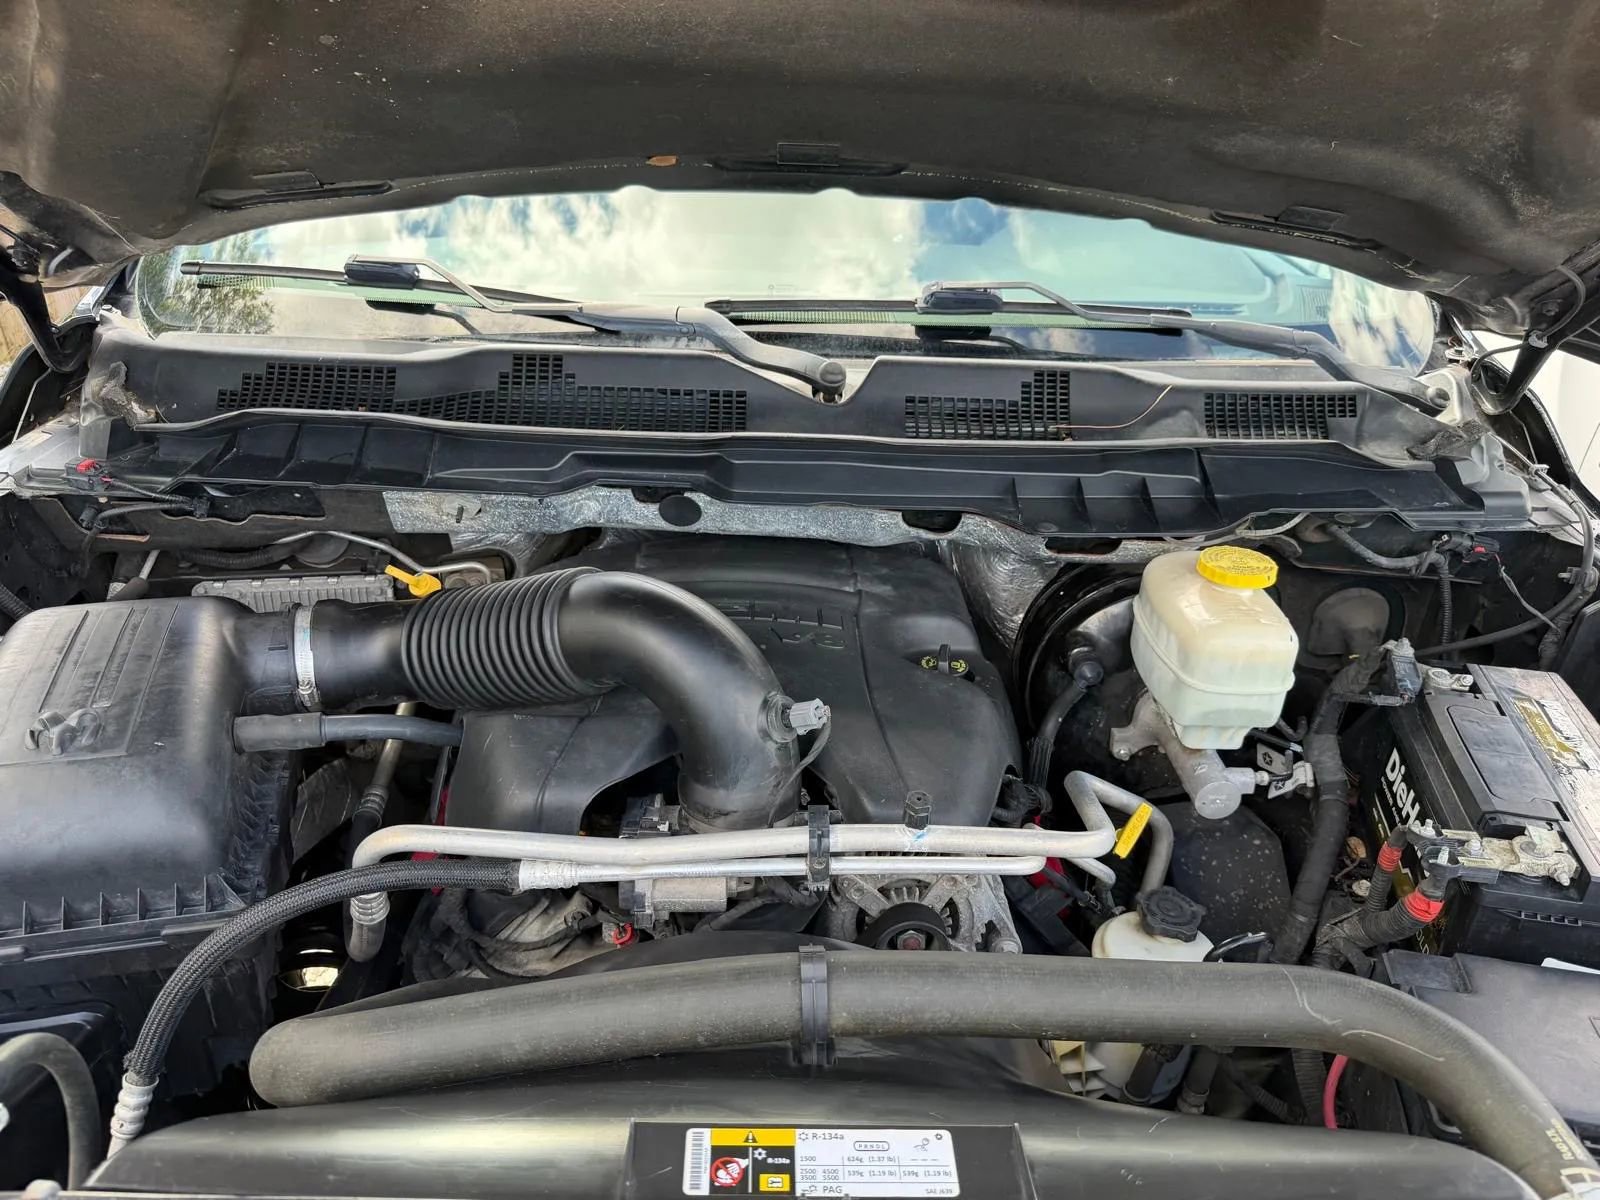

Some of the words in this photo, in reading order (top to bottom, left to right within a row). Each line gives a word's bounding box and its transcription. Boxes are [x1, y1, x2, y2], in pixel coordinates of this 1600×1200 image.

[1385, 747, 1421, 828] DieH
[812, 1132, 844, 1141] R-134a
[823, 1186, 842, 1194] PAG
